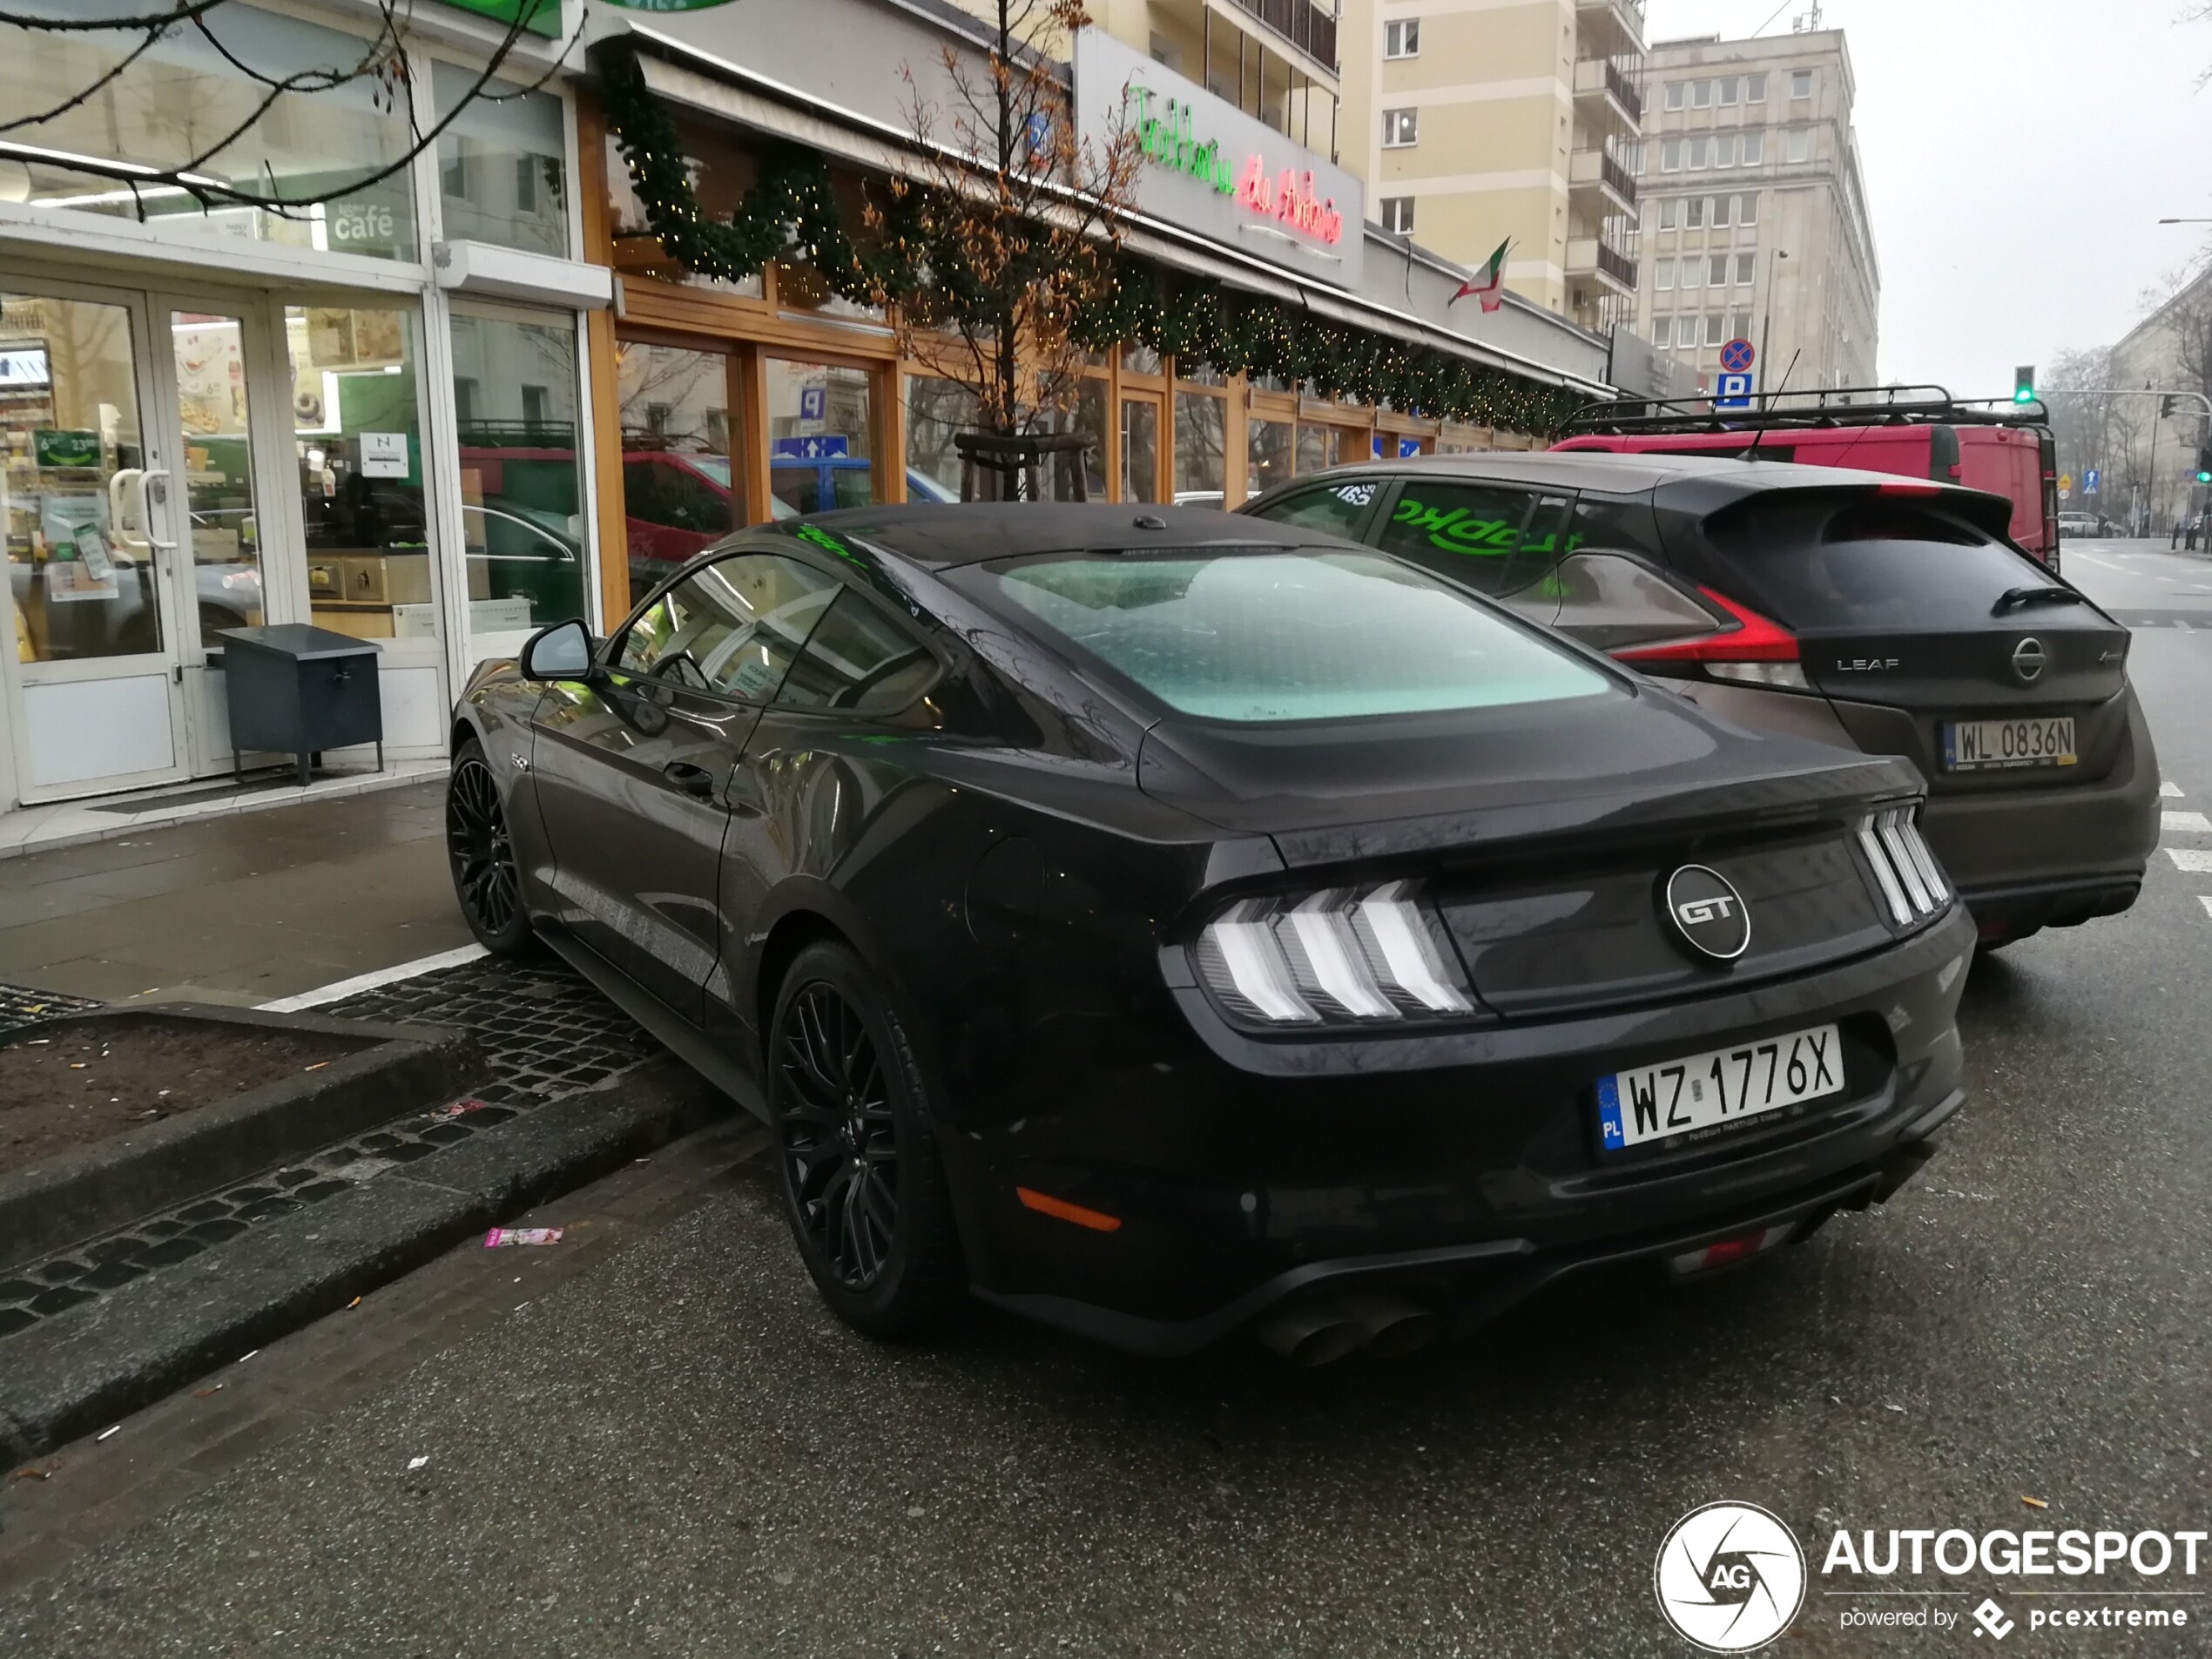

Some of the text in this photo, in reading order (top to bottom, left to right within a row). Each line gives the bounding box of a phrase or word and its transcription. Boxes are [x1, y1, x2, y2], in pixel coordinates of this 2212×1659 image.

[1247, 154, 1273, 212] da
[1278, 169, 1342, 244] Antonio
[334, 205, 393, 239] café
[1723, 376, 1746, 403] P
[1837, 658, 1899, 671] LEAF
[1961, 721, 2072, 760] WL 0836N
[1679, 895, 1734, 924] GT
[1629, 1032, 1834, 1136] WZ 1776X
[1603, 1120, 1621, 1138] PL
